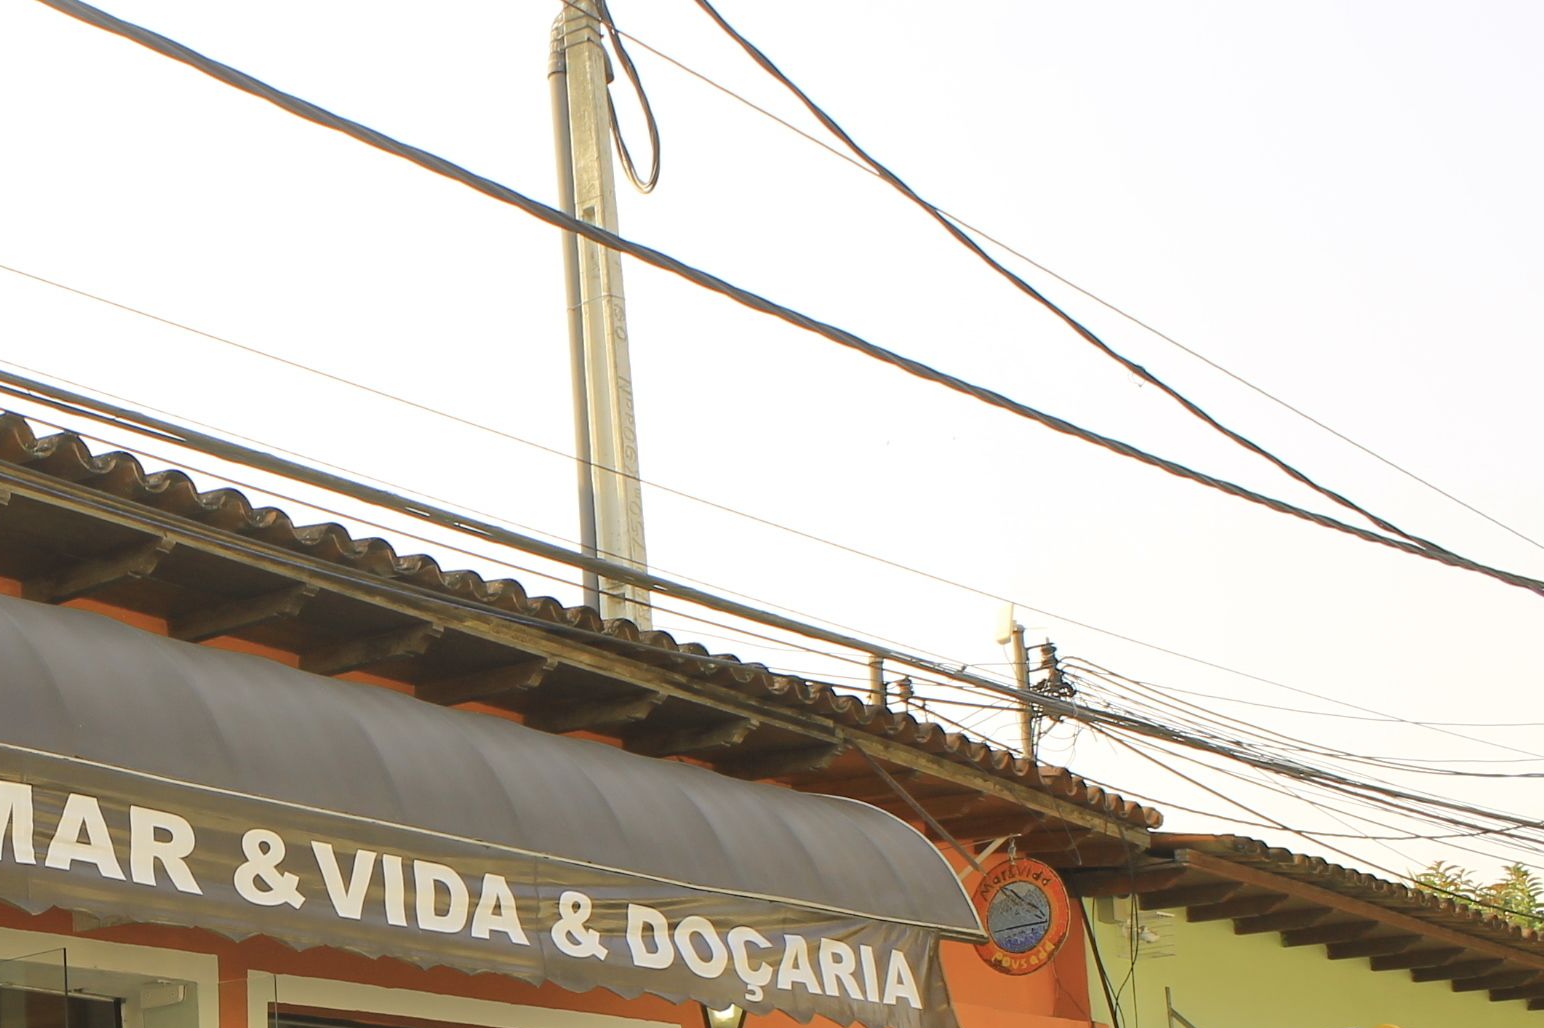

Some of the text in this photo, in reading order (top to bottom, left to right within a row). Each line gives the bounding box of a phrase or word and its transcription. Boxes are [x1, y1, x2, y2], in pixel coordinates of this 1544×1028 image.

[233, 828, 305, 910] &
[311, 840, 529, 947] VIDA
[550, 890, 608, 961] &
[626, 903, 923, 1010] DOÇARIA
